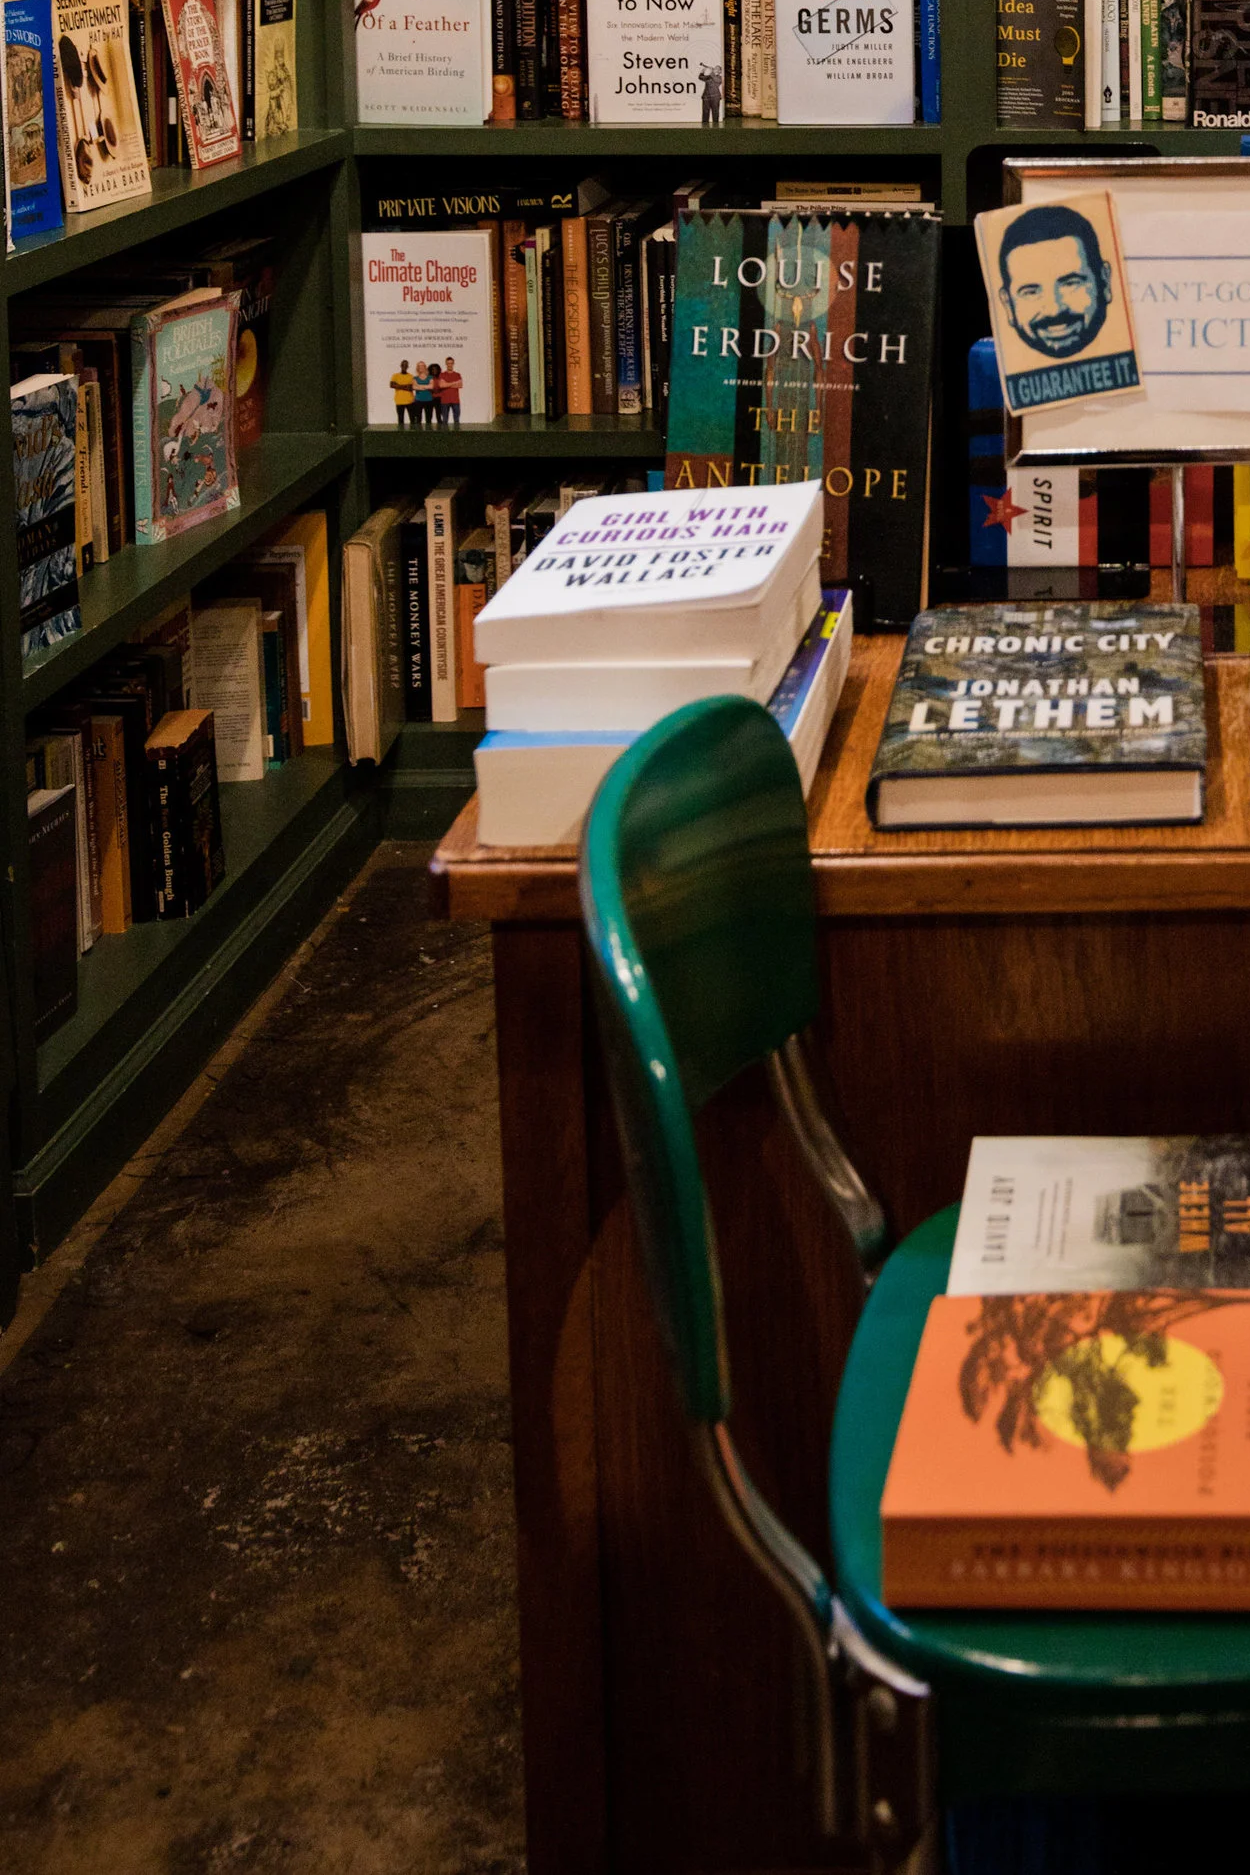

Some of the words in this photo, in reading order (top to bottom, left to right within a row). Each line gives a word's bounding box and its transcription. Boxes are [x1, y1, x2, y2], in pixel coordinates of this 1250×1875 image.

[59, 4, 123, 33] ENLIGHTENMENT
[361, 12, 386, 31] Of
[388, 19, 397, 31] a
[403, 14, 471, 32] Feather
[797, 7, 895, 35] GERMS
[997, 26, 1042, 42] Must
[622, 51, 690, 70] Steven
[997, 52, 1027, 69] Die
[614, 76, 698, 95] Johnson
[378, 197, 437, 218] PRIMATE
[440, 195, 501, 216] VISIONS
[390, 247, 406, 263] The
[368, 259, 423, 284] Climate
[425, 261, 477, 288] Change
[711, 255, 885, 294] LOUISE
[402, 285, 453, 306] Playbook
[690, 325, 909, 365] ERDRICH
[1007, 378, 1017, 408] I
[1019, 361, 1113, 405] GUARANTEE
[1114, 357, 1138, 387] IT.
[748, 405, 823, 436] THE
[600, 510, 671, 527] GIRL
[686, 504, 769, 522] WITH
[1033, 477, 1053, 550] SPIRIT
[556, 525, 697, 546] CURIOUS
[709, 520, 790, 537] HAIR
[408, 557, 418, 585] THE
[532, 550, 639, 573] DAVID
[646, 543, 777, 566] FOSTER
[563, 563, 721, 588] WALLACE
[408, 590, 421, 648] MONKEY
[924, 634, 1085, 655] CHRONIC
[1096, 631, 1178, 652] CITY
[411, 652, 422, 688] WARS
[951, 677, 1141, 698] JONATHAN
[908, 694, 1175, 733] LETHEM
[1179, 1179, 1211, 1253] WHERE
